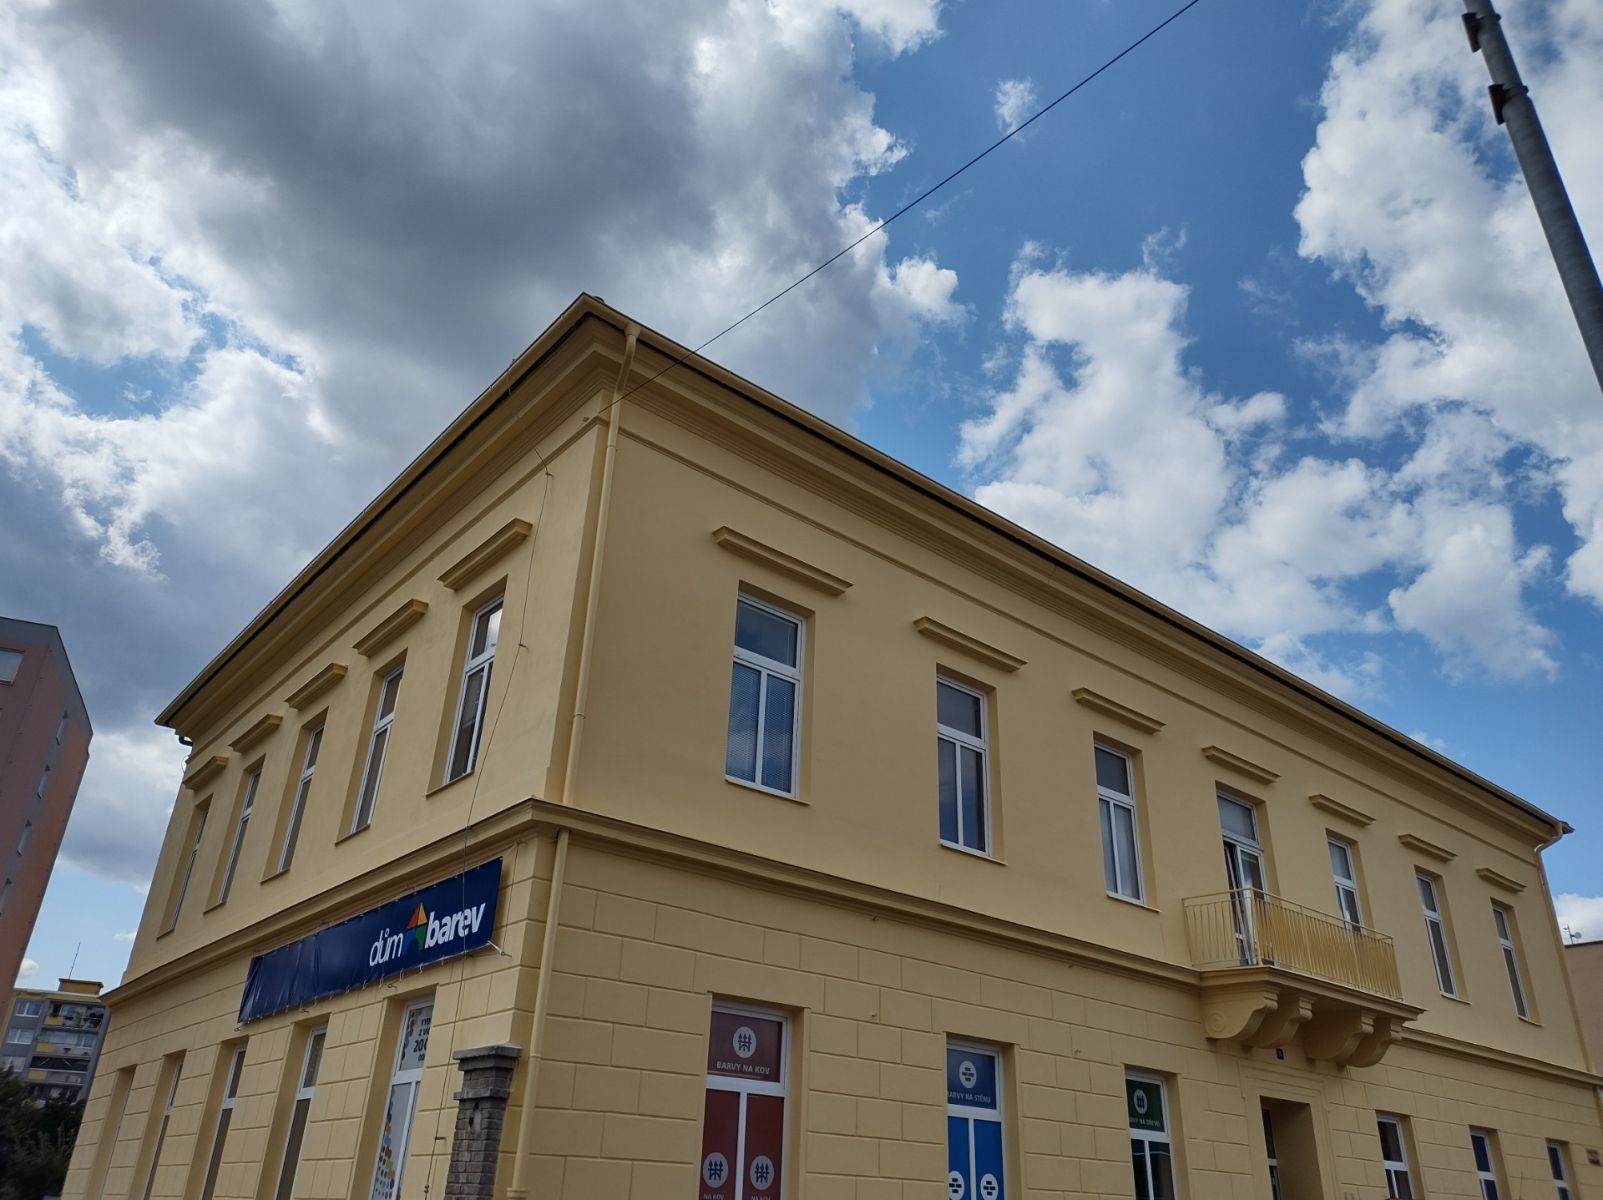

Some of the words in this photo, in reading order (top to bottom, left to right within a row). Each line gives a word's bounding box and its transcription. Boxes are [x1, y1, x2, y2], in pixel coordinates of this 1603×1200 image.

[369, 928, 403, 967] dům
[425, 903, 486, 949] barev
[716, 1060, 741, 1072] BARVY
[742, 1064, 753, 1073] NA
[755, 1065, 770, 1075] KOV
